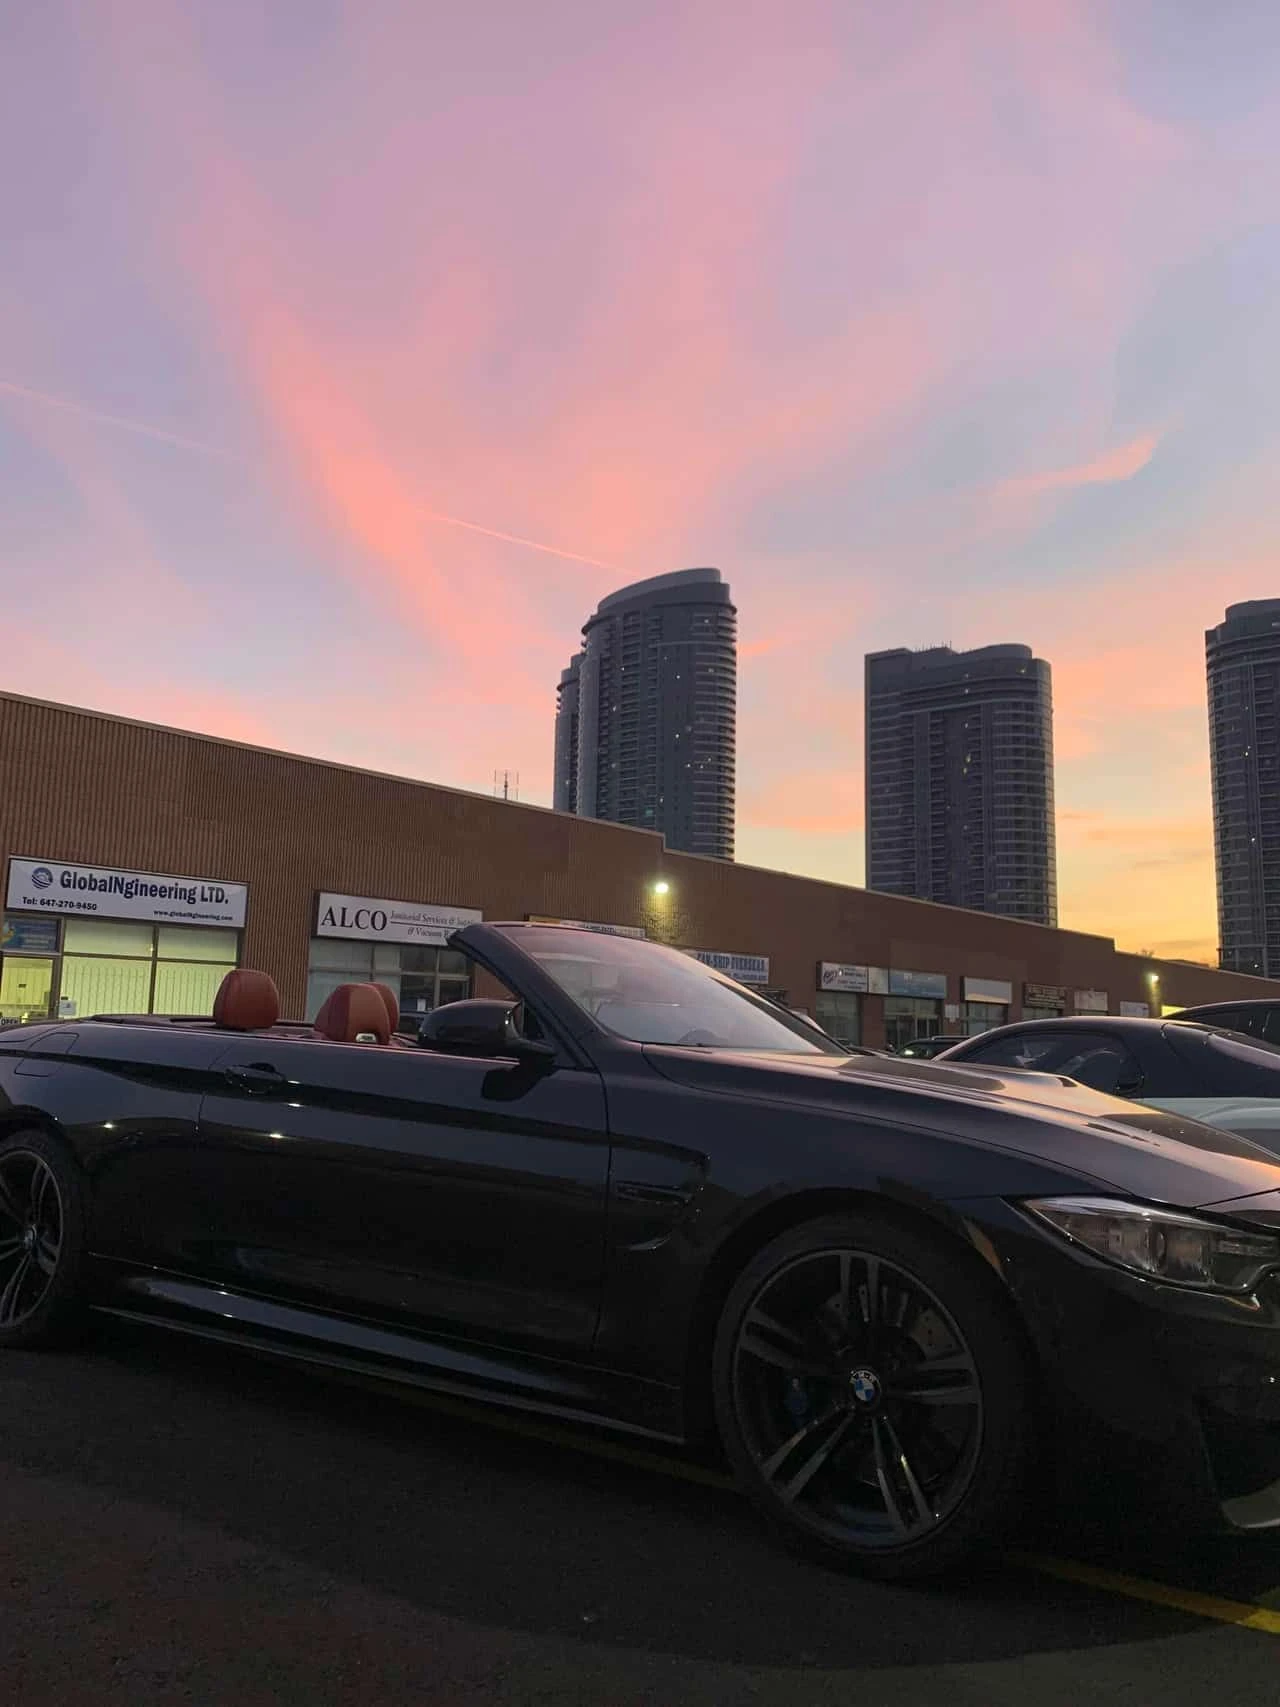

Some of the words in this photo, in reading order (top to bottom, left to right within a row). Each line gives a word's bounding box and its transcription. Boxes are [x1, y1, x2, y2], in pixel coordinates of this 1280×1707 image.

[60, 870, 197, 904] GlobalNgineering
[201, 886, 229, 904] LTD.
[39, 898, 98, 911] 647-270-9450
[321, 906, 387, 931] ALCO
